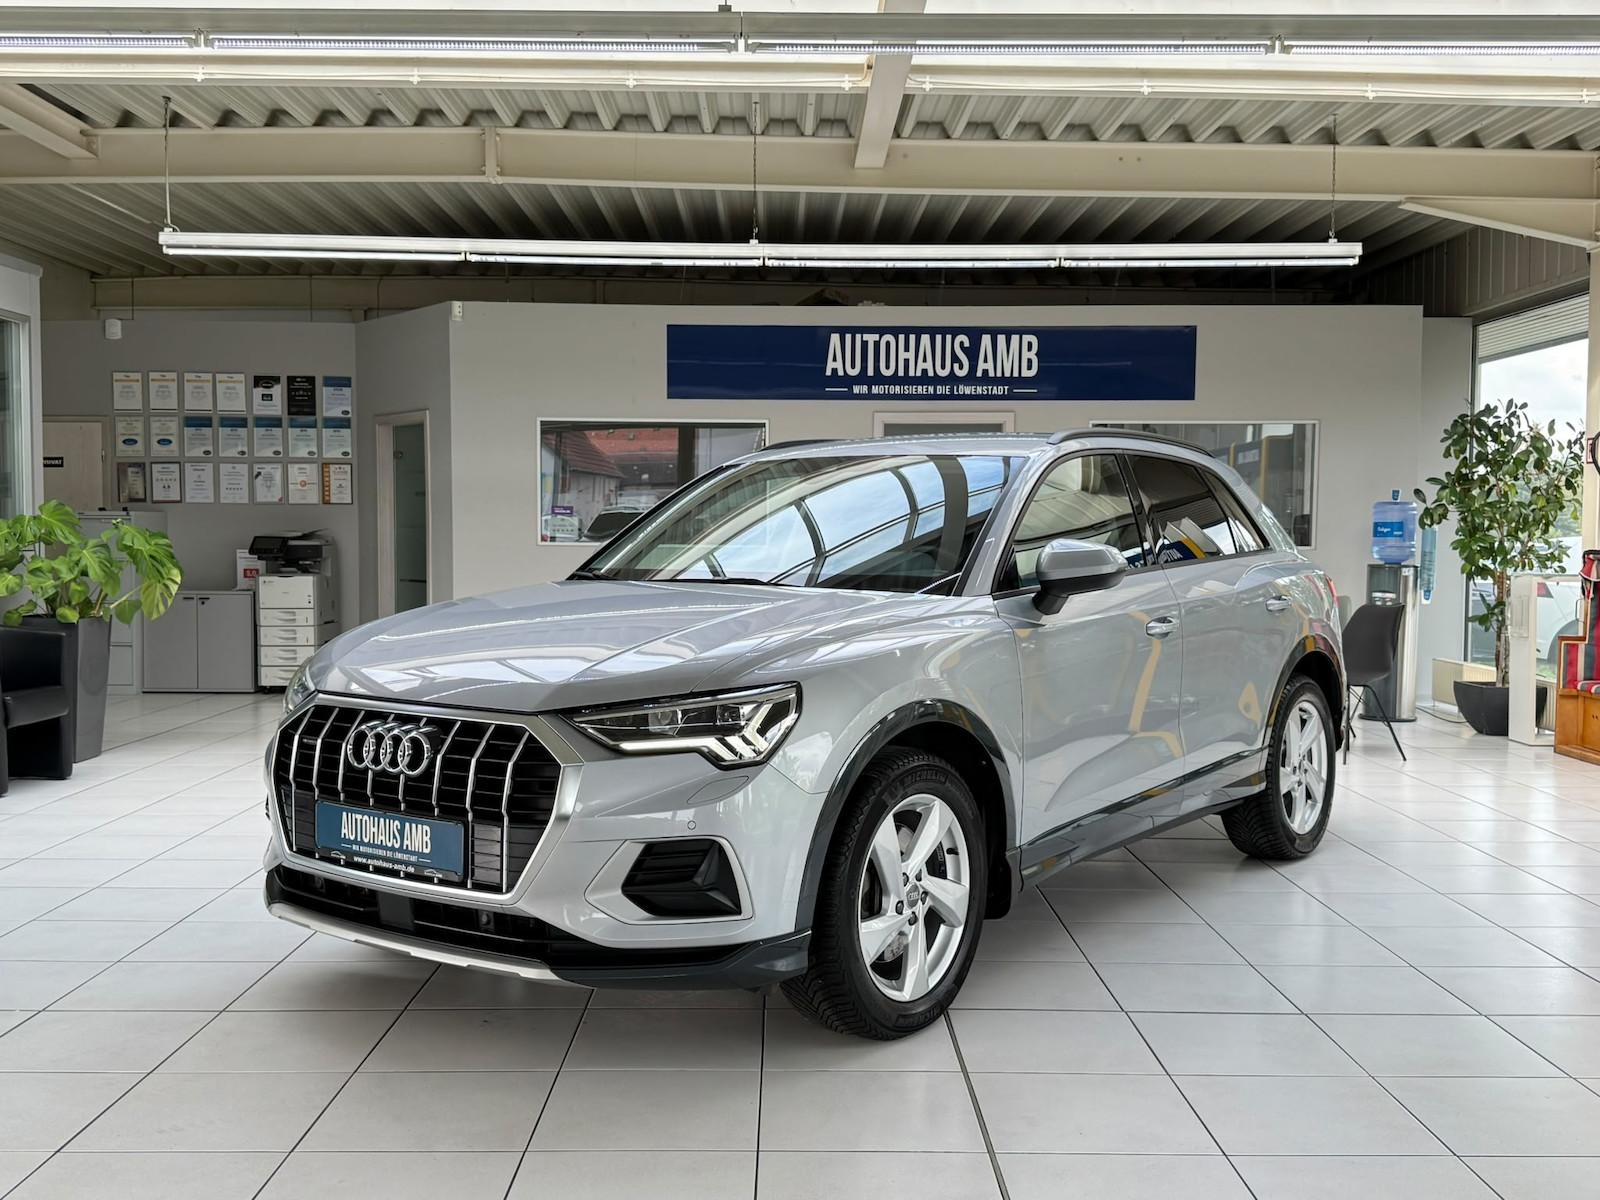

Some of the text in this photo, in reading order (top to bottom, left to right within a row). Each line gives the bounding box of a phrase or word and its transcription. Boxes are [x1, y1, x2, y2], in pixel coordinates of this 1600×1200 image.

[825, 333, 1039, 377] AUTOHAUS AMB
[852, 384, 1009, 395] WIR MOTORISIEREN DIE LÖWENSTADT
[341, 811, 431, 854] AUTOHAUS AMB
[353, 856, 415, 873] www.autohaus-amb.de
